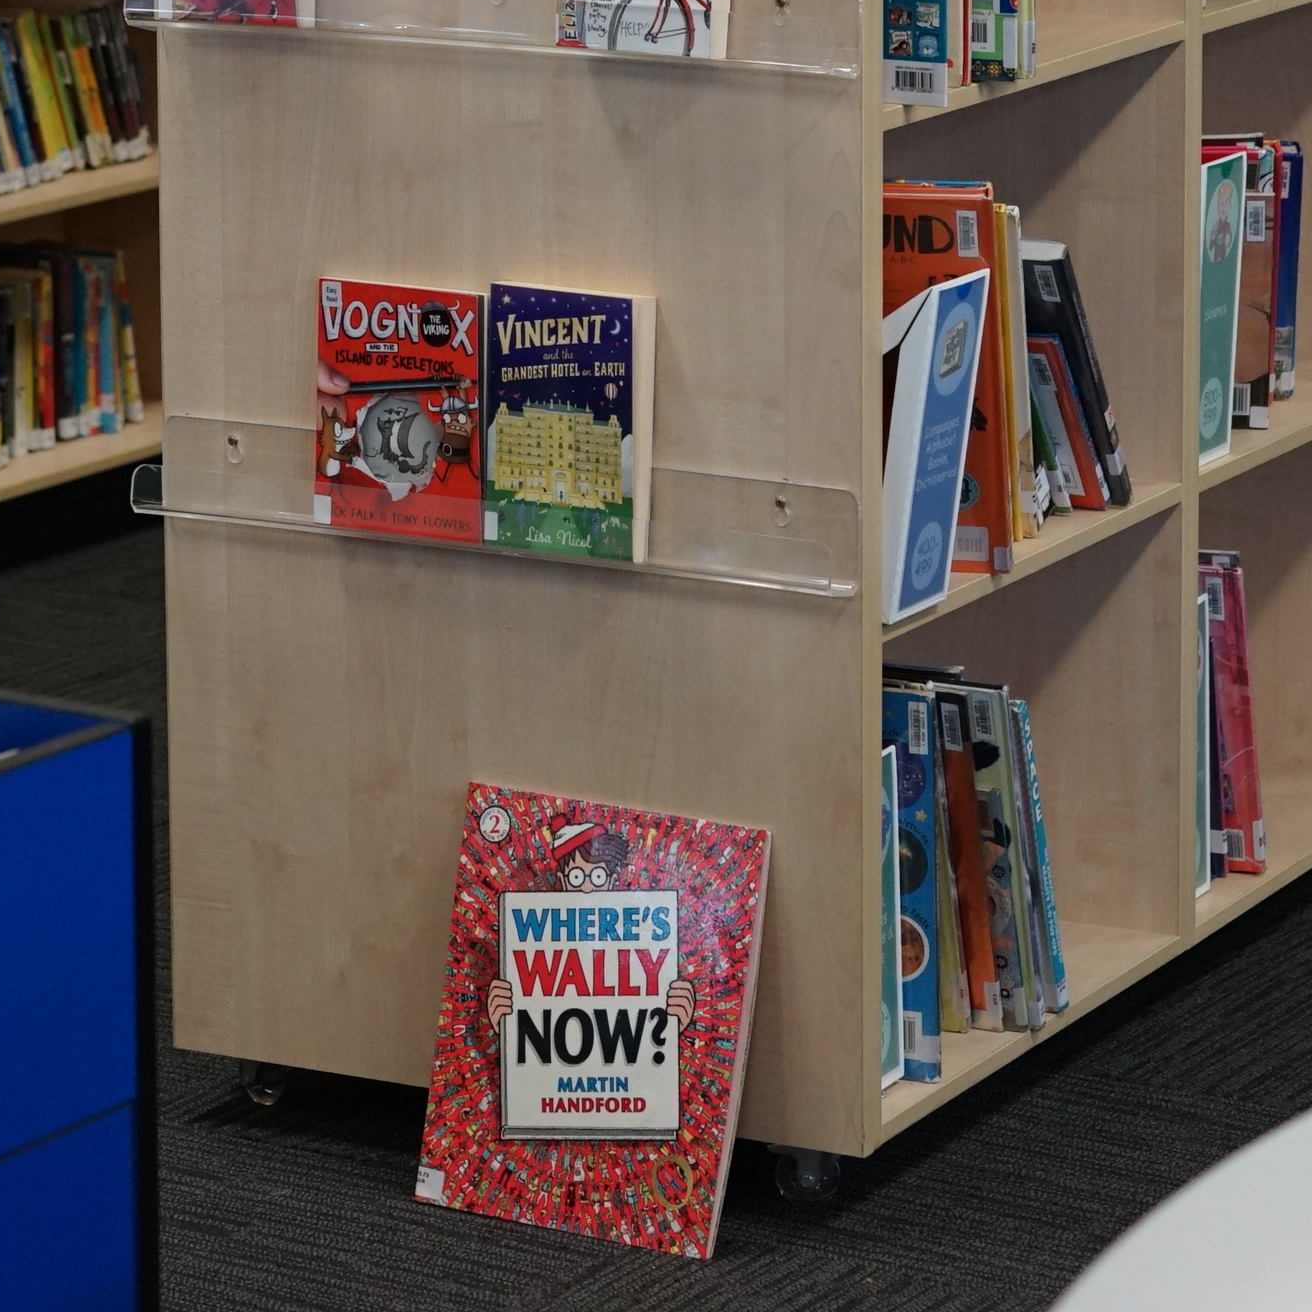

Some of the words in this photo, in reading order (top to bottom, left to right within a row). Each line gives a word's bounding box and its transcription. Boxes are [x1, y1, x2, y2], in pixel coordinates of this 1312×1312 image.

[326, 286, 338, 296] Easy
[326, 295, 338, 303] Read
[423, 323, 450, 336] VIKING
[429, 315, 441, 324] THE
[496, 314, 607, 355] VINCENT
[335, 349, 373, 367] ISLAND
[376, 354, 390, 367] OF
[392, 354, 455, 376] SKELETONS
[543, 348, 560, 361] and
[562, 348, 575, 360] the
[501, 364, 549, 383] GRANDEST
[551, 363, 580, 378] HOTEL
[594, 361, 626, 377] EARTH
[351, 508, 376, 521] FALK
[391, 513, 418, 526] TONY
[423, 516, 472, 532] FLOWERS
[525, 526, 553, 544] Lisa
[556, 530, 592, 549] Nicol
[914, 557, 934, 578] 499
[1024, 718, 1043, 823] SPACE
[489, 814, 501, 834] 2
[512, 906, 671, 942] WHERE'S
[512, 949, 671, 998] WALLY
[516, 1007, 669, 1066] NOW?
[557, 1077, 629, 1093] MARTIN
[541, 1097, 647, 1114] HANDFORD
